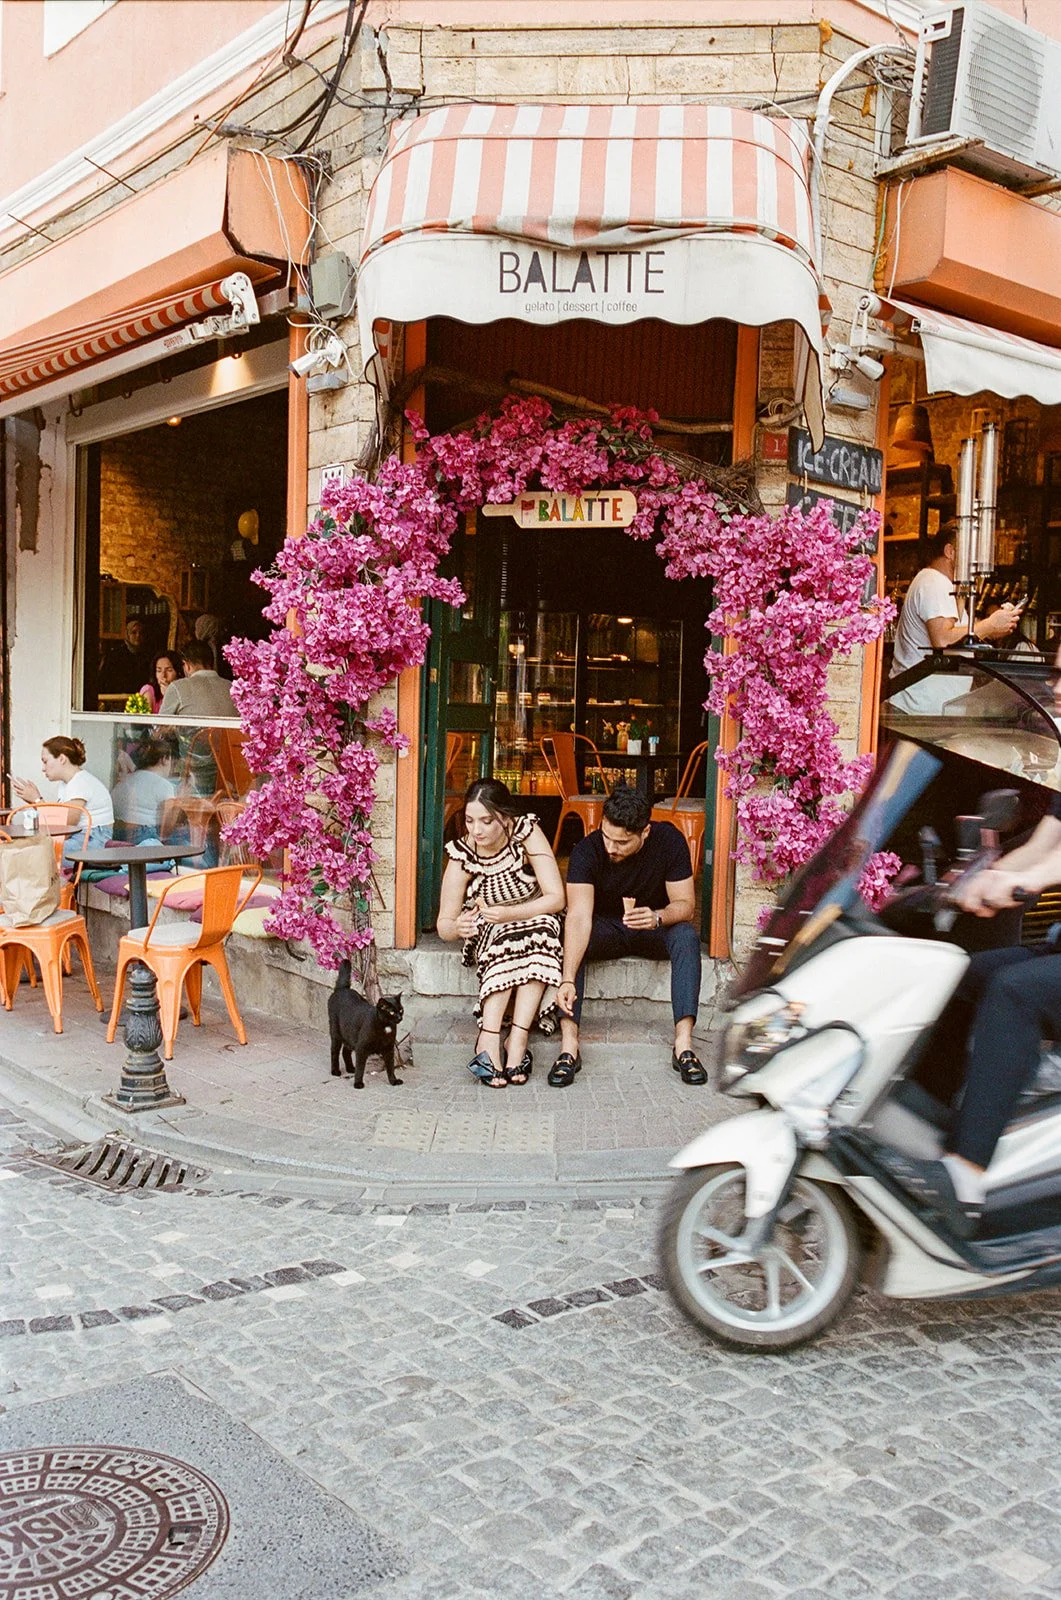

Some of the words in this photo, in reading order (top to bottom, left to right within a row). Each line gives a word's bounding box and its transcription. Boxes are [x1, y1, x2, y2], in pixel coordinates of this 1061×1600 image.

[499, 251, 665, 293] BALATTE
[525, 302, 554, 314] gelato
[563, 302, 598, 312] dessert
[607, 302, 638, 312] coffee
[539, 498, 623, 522] BALATTE
